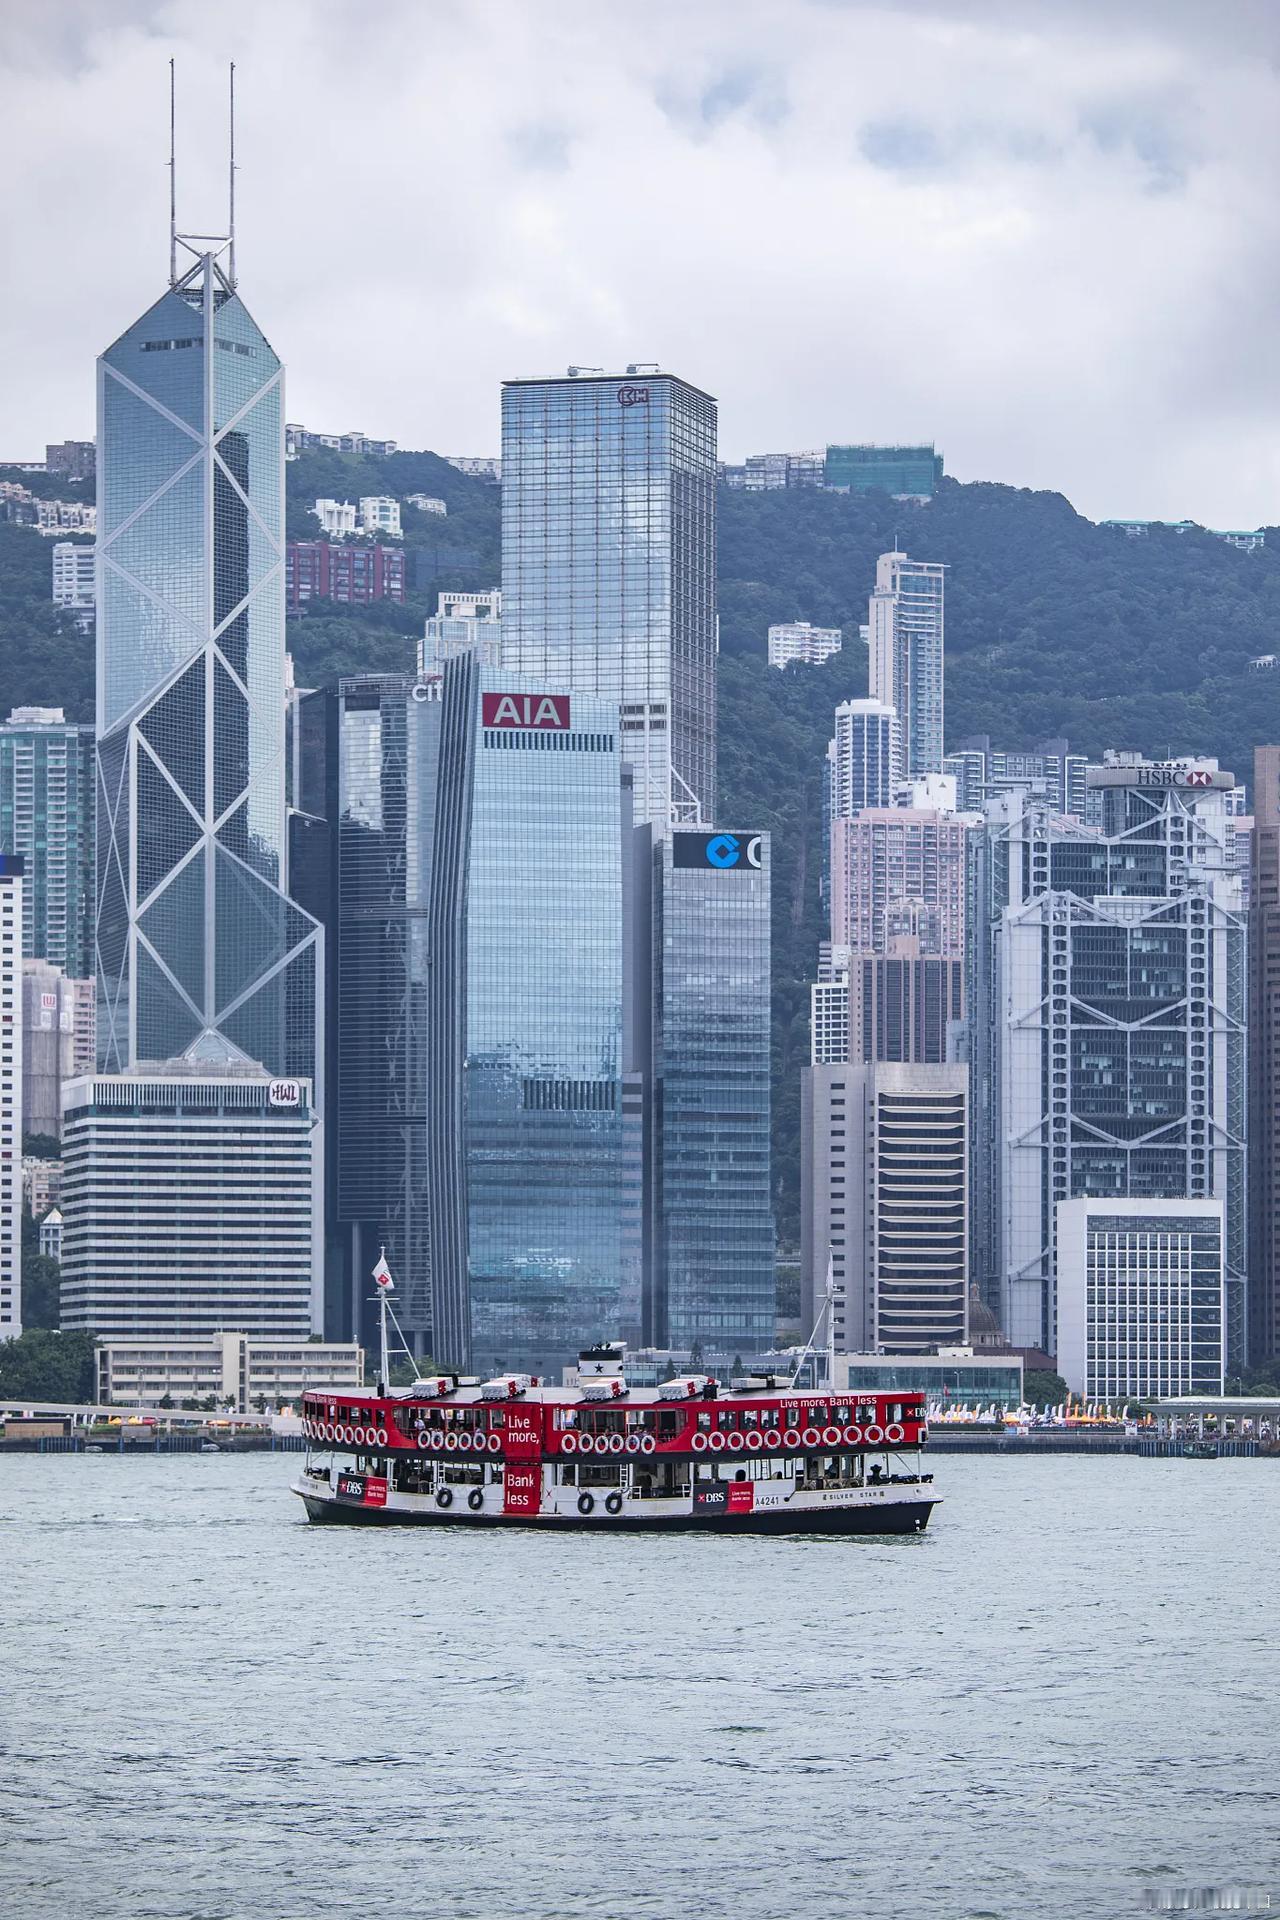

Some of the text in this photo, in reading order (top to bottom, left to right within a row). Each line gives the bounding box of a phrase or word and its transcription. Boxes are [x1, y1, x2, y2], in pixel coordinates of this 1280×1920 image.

[493, 696, 562, 726] AIA
[1137, 770, 1185, 785] HSBC
[272, 1084, 297, 1101] HWL
[780, 1395, 877, 1408] Live more, Bank less
[508, 1415, 530, 1428] Live
[508, 1432, 540, 1444] more,
[507, 1473, 535, 1487] Bank
[346, 1481, 363, 1495] DBS
[507, 1490, 529, 1505] less
[706, 1492, 724, 1503] DBS
[756, 1496, 779, 1506] A4241
